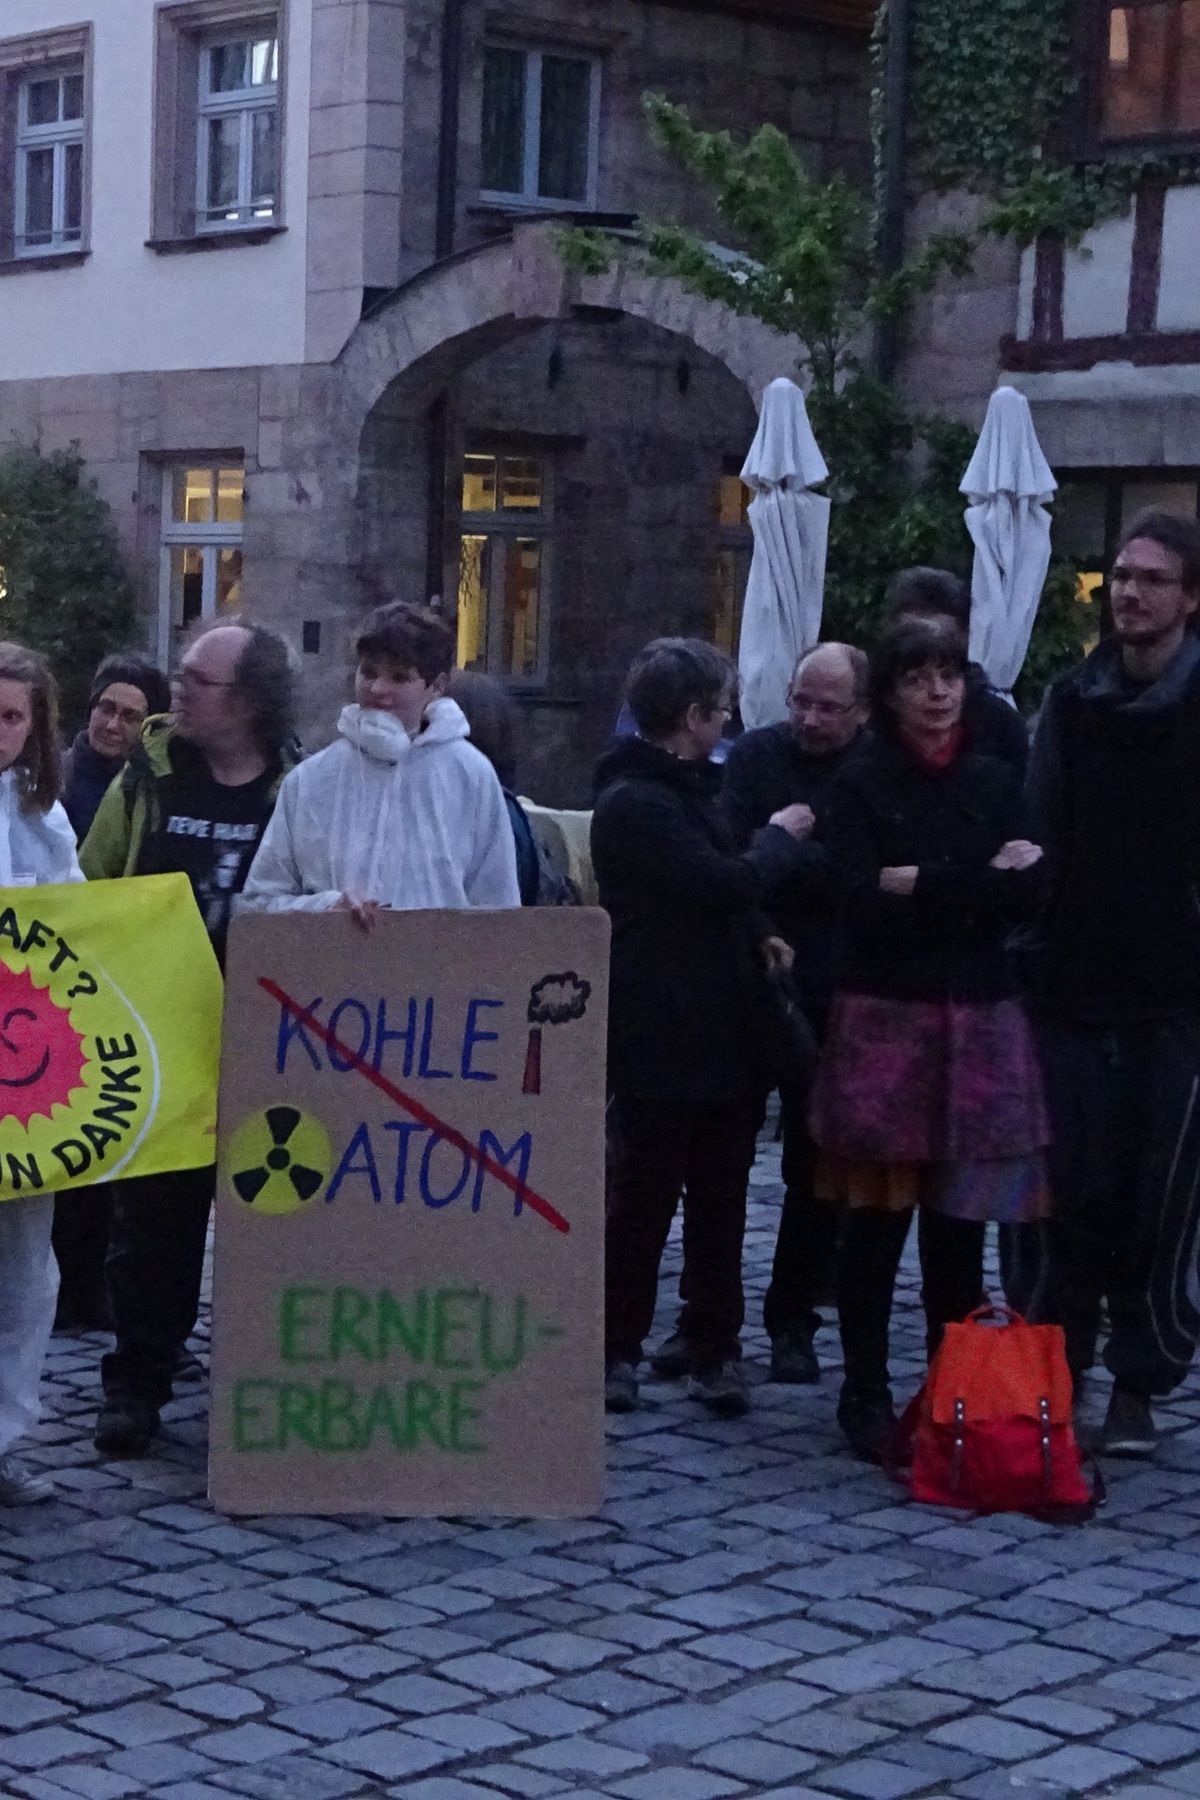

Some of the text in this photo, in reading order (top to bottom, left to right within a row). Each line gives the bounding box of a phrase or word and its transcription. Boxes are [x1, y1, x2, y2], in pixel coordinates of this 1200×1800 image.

[276, 996, 503, 1081] KOHLE
[52, 1033, 142, 1178] DANKE
[325, 1121, 532, 1217] ATOM
[280, 1284, 564, 1374] ERNEU-
[233, 1377, 487, 1453] ERBARE
